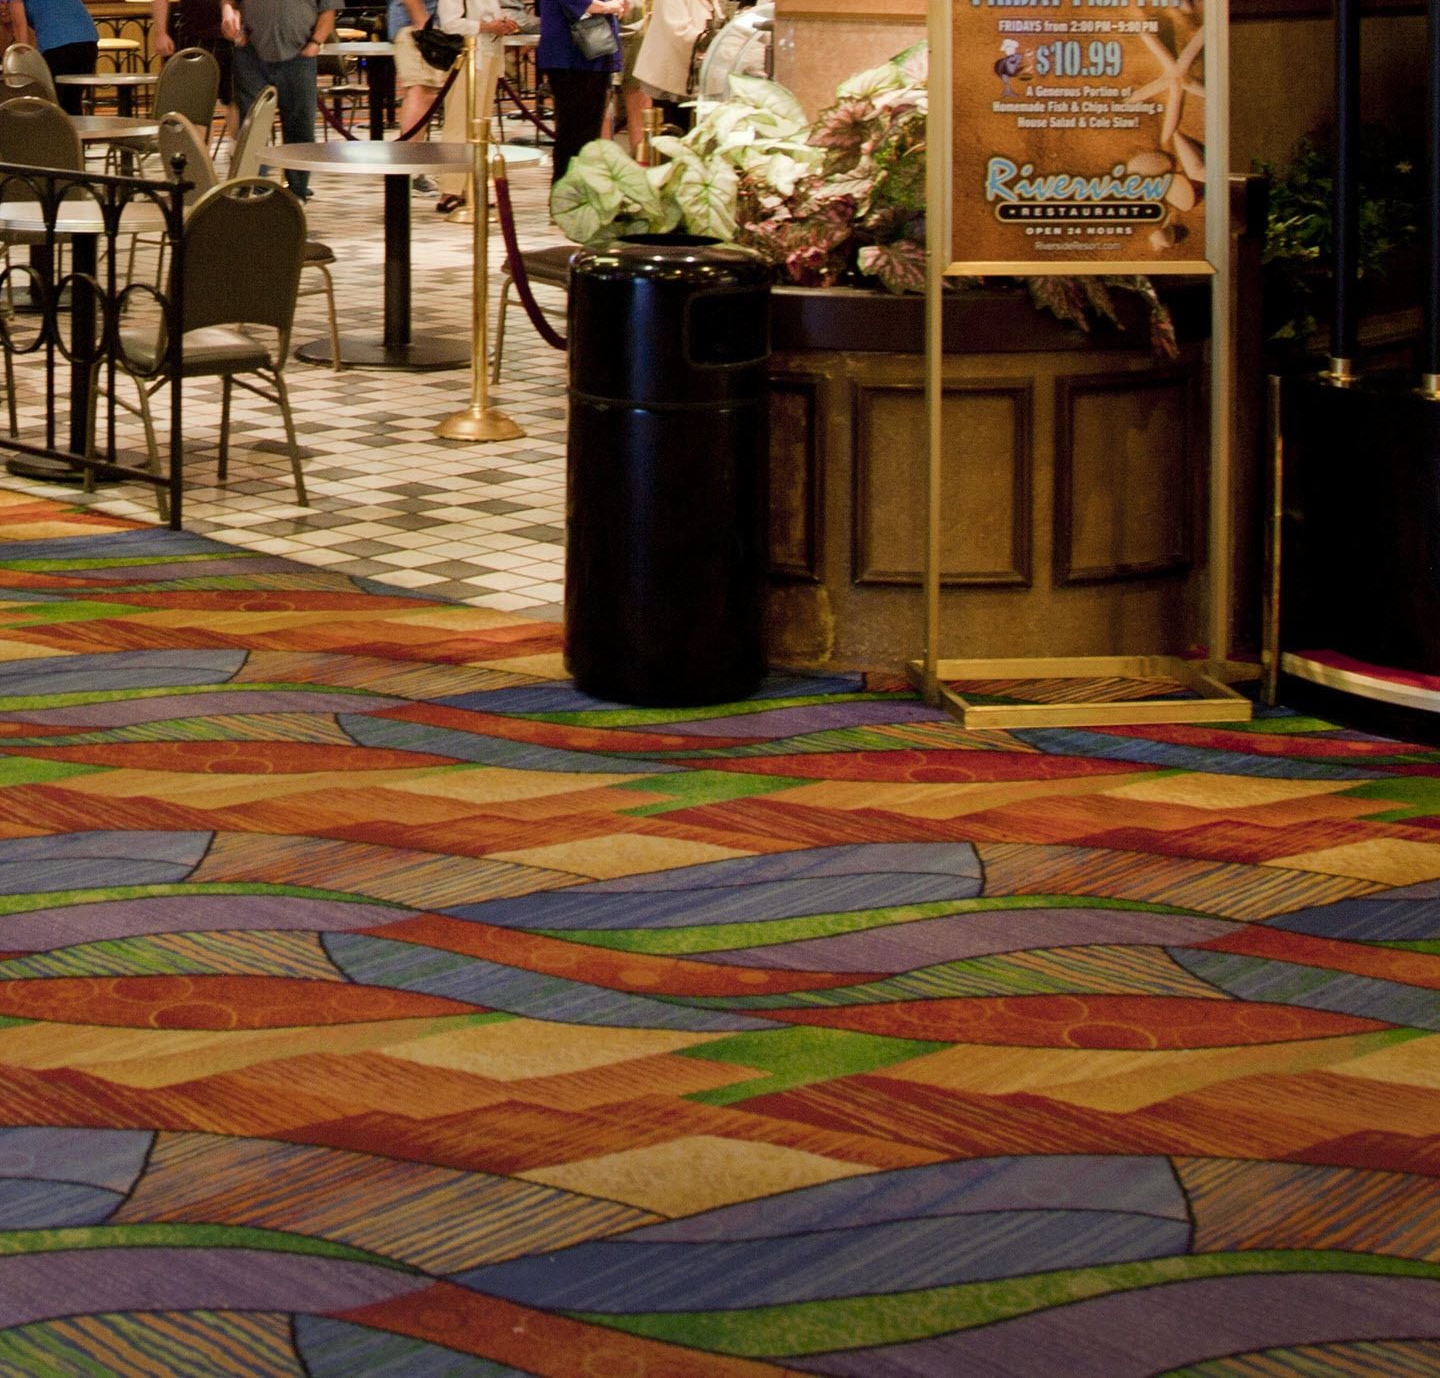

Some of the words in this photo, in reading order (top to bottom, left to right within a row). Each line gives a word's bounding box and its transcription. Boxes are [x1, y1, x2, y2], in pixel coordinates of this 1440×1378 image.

[998, 20, 1042, 32] FRIDAYS
[1043, 21, 1068, 32] from
[1035, 41, 1123, 77] $10.99
[1025, 86, 1033, 97] A
[1035, 86, 1081, 97] Generous
[1083, 86, 1119, 97] Portion
[1121, 86, 1132, 97] of
[993, 101, 1046, 113] Homemade
[1047, 101, 1069, 112] Fish
[1071, 101, 1079, 112] &
[1081, 101, 1109, 114] Chips
[1111, 101, 1155, 115] including
[1156, 104, 1163, 113] a
[1017, 117, 1048, 128] House
[1049, 117, 1076, 128] Salad
[1078, 117, 1087, 128] &
[1088, 117, 1111, 128] Cole
[1112, 117, 1140, 128] Slaw!
[985, 157, 1172, 203] Riverview
[1021, 207, 1141, 217] RESTAURANT
[1025, 226, 1062, 236] OPEN
[1067, 227, 1082, 235] 24
[1086, 226, 1133, 235] HOURS
